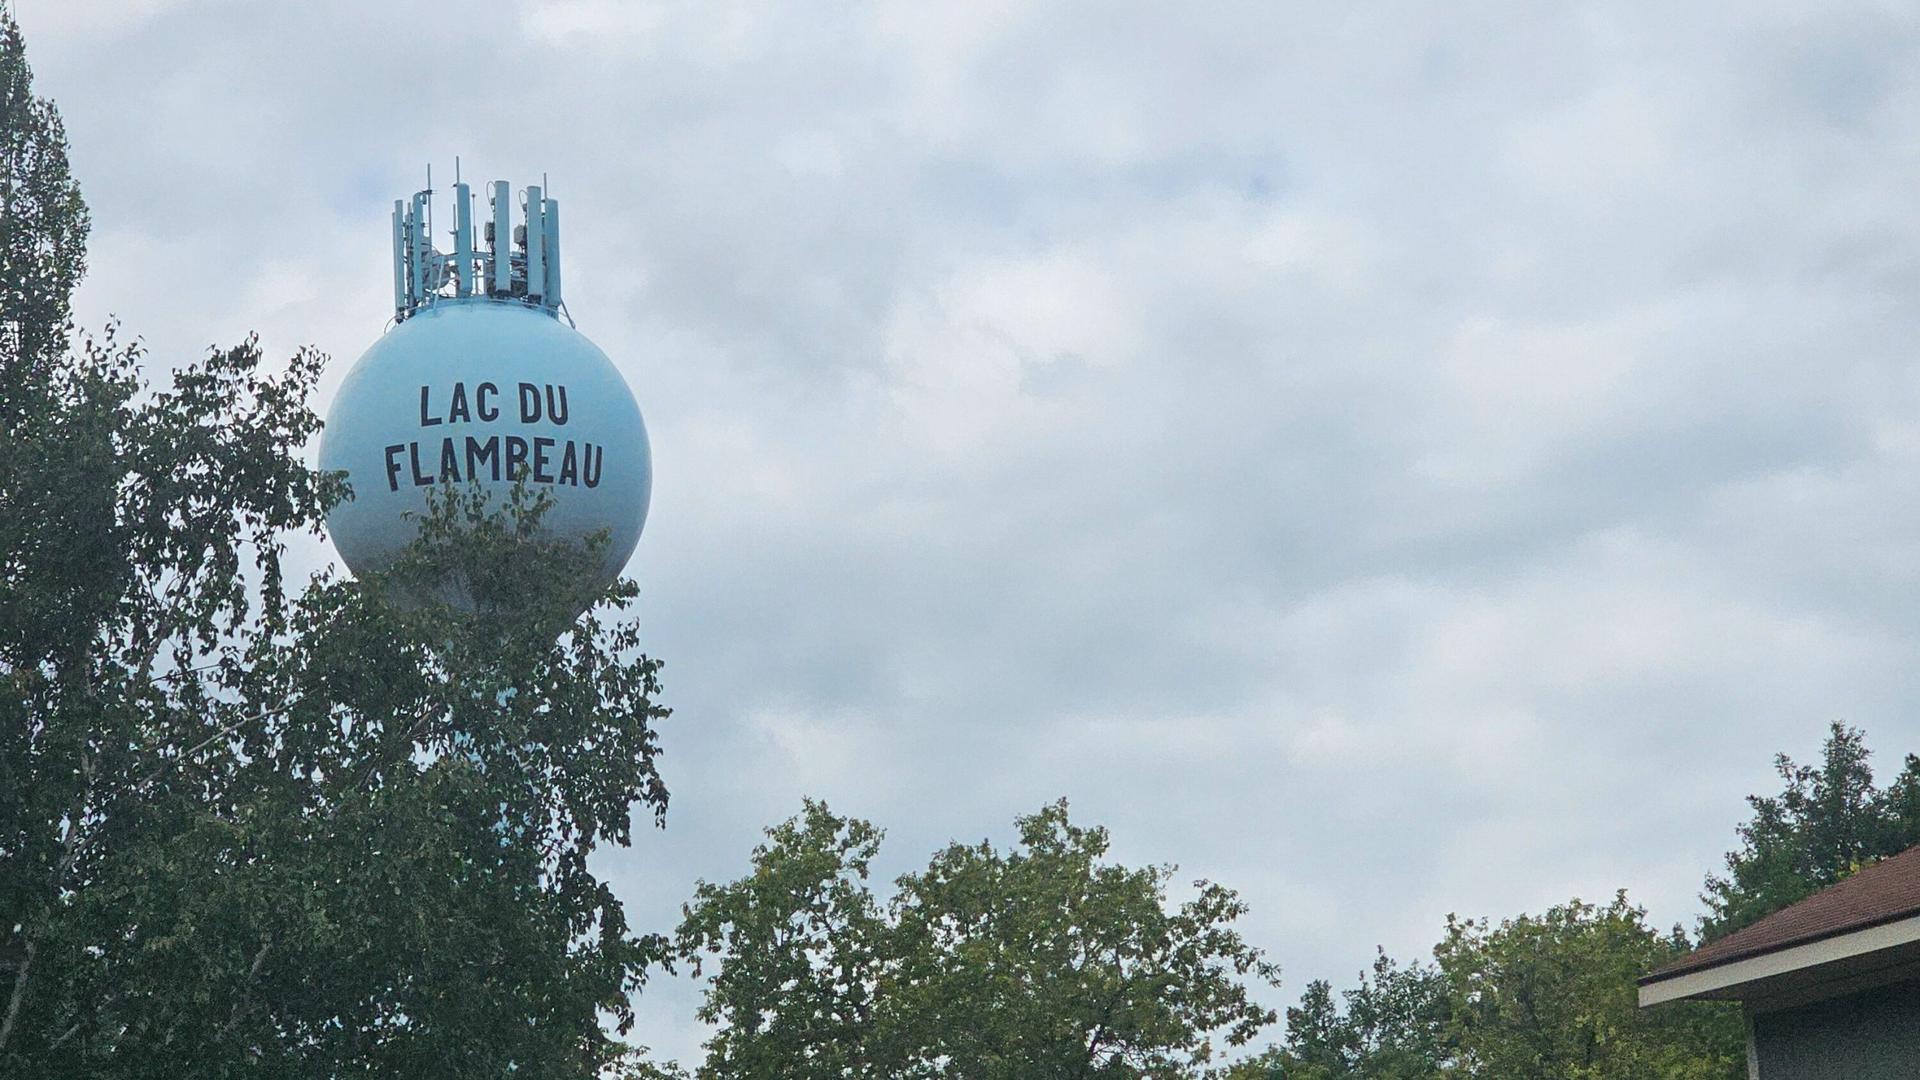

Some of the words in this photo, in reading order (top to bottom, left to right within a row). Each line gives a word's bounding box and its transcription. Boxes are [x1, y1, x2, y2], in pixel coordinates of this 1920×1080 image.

[420, 382, 500, 427] LAC
[518, 382, 569, 426] DU
[385, 435, 603, 492] FLAMBEAU
